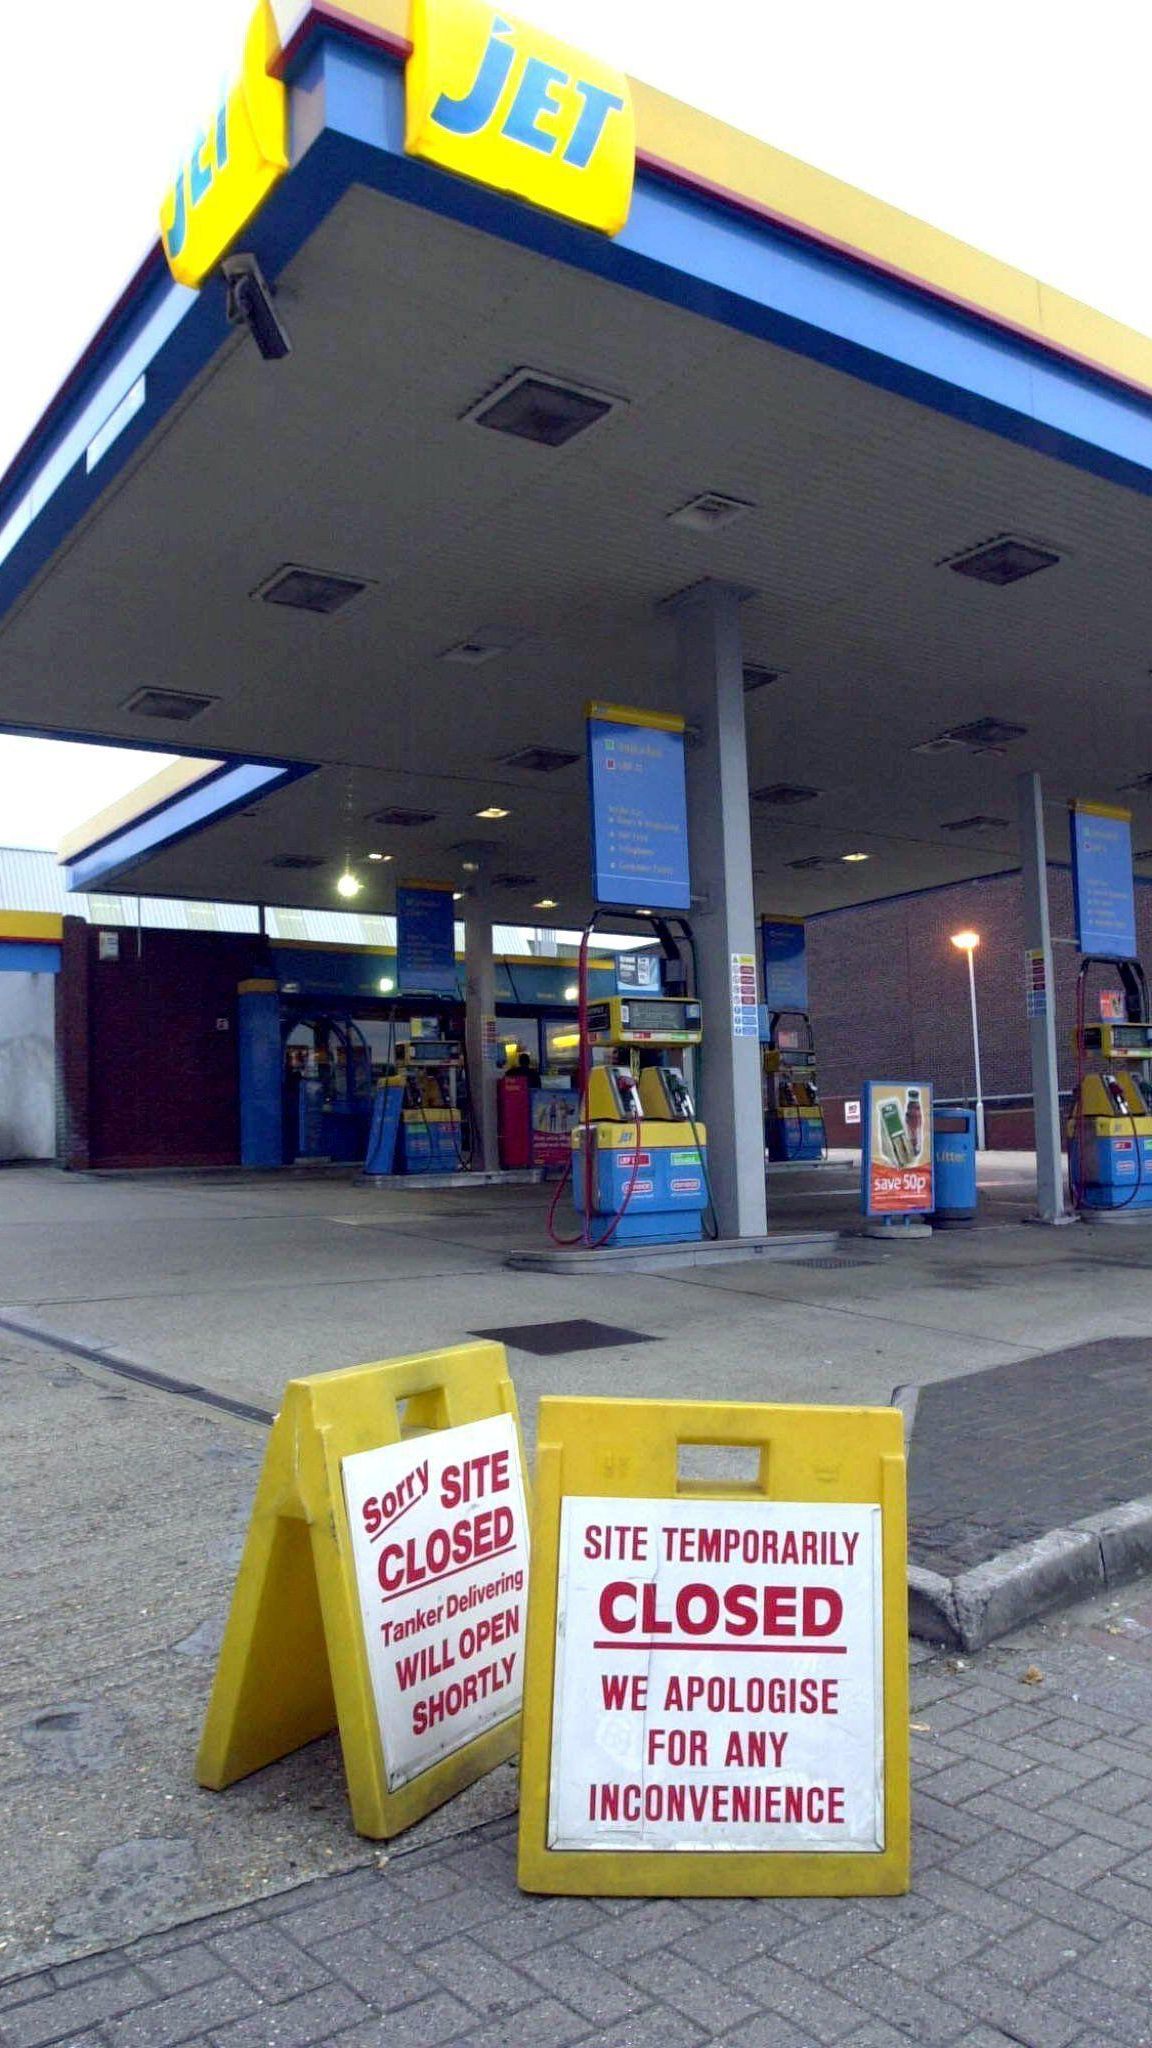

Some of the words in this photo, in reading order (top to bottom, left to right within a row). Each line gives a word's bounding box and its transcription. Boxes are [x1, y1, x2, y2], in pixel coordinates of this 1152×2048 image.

[430, 15, 624, 168] JET
[874, 1177, 901, 1191] save
[903, 1173, 926, 1193] 50p
[362, 1459, 430, 1533] Sorry
[440, 1450, 510, 1510] SITE
[378, 1506, 514, 1592] CLOSED
[584, 1525, 648, 1561] SITE
[663, 1528, 860, 1566] TEMPORARILY
[381, 1604, 444, 1648] Tanker
[446, 1569, 524, 1620] Delivering
[599, 1581, 843, 1638] CLOSED
[395, 1639, 455, 1691] WILL
[459, 1605, 520, 1660] OPEN
[412, 1653, 517, 1736] SHORTLY
[601, 1675, 648, 1712] WE
[664, 1676, 840, 1715] APOLOGISE
[647, 1728, 708, 1767] FOR
[725, 1731, 789, 1768] ANY
[589, 1784, 845, 1825] INCONVENIENCE
